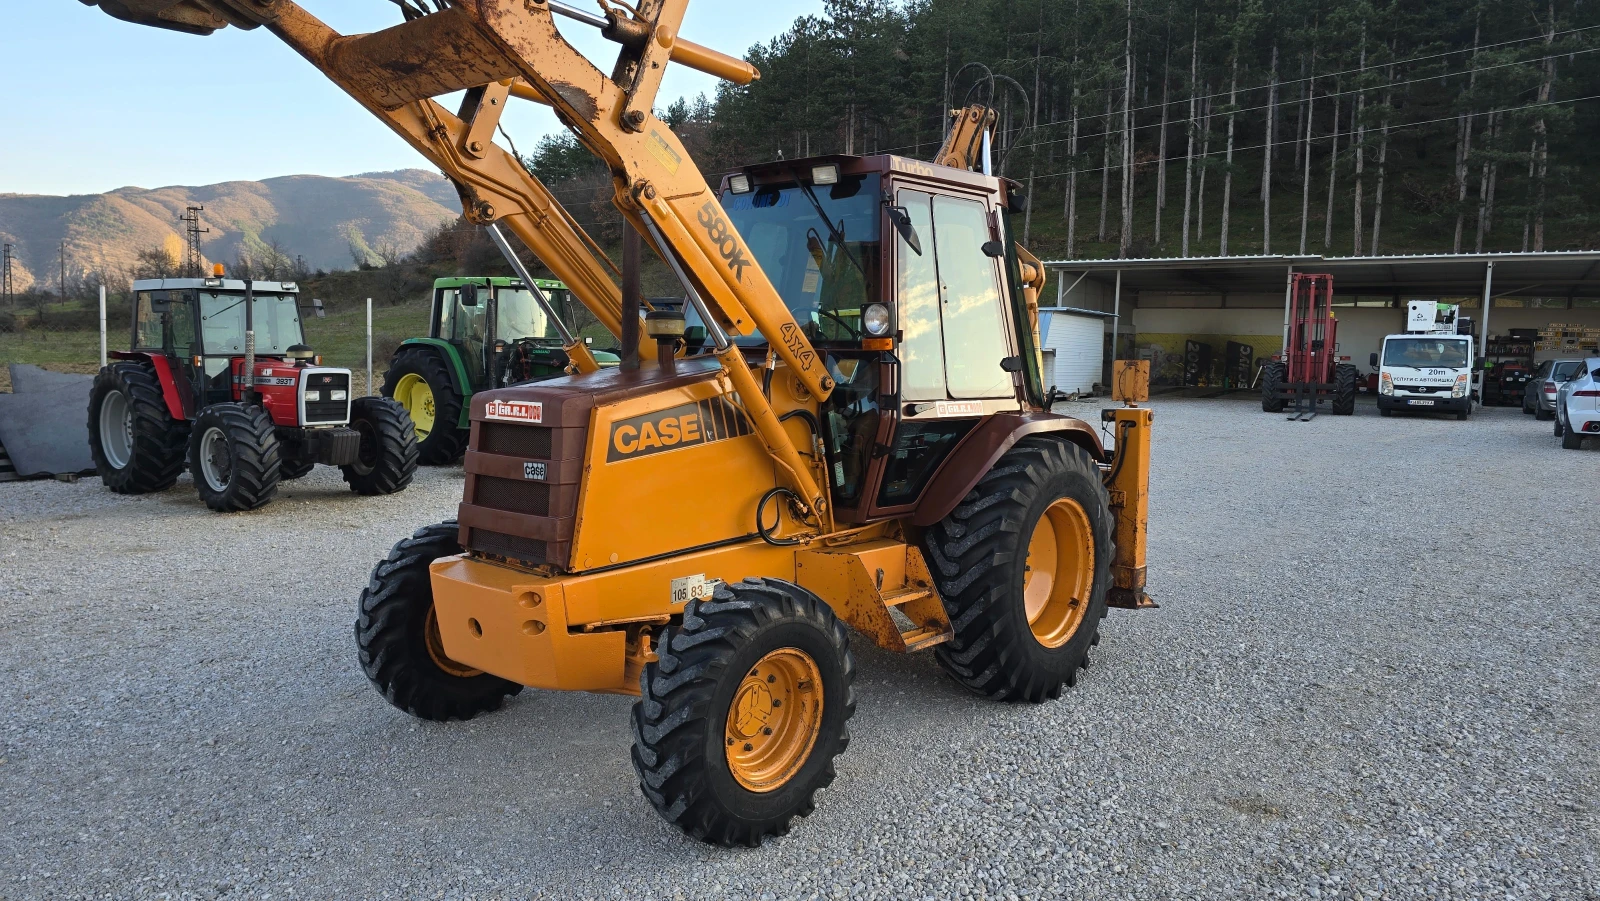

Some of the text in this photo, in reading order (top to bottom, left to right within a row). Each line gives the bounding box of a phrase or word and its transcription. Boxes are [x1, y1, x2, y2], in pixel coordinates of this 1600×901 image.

[697, 200, 752, 284] 580K
[613, 413, 701, 454] CASE
[673, 588, 687, 601] 105
[690, 584, 703, 598] 83
